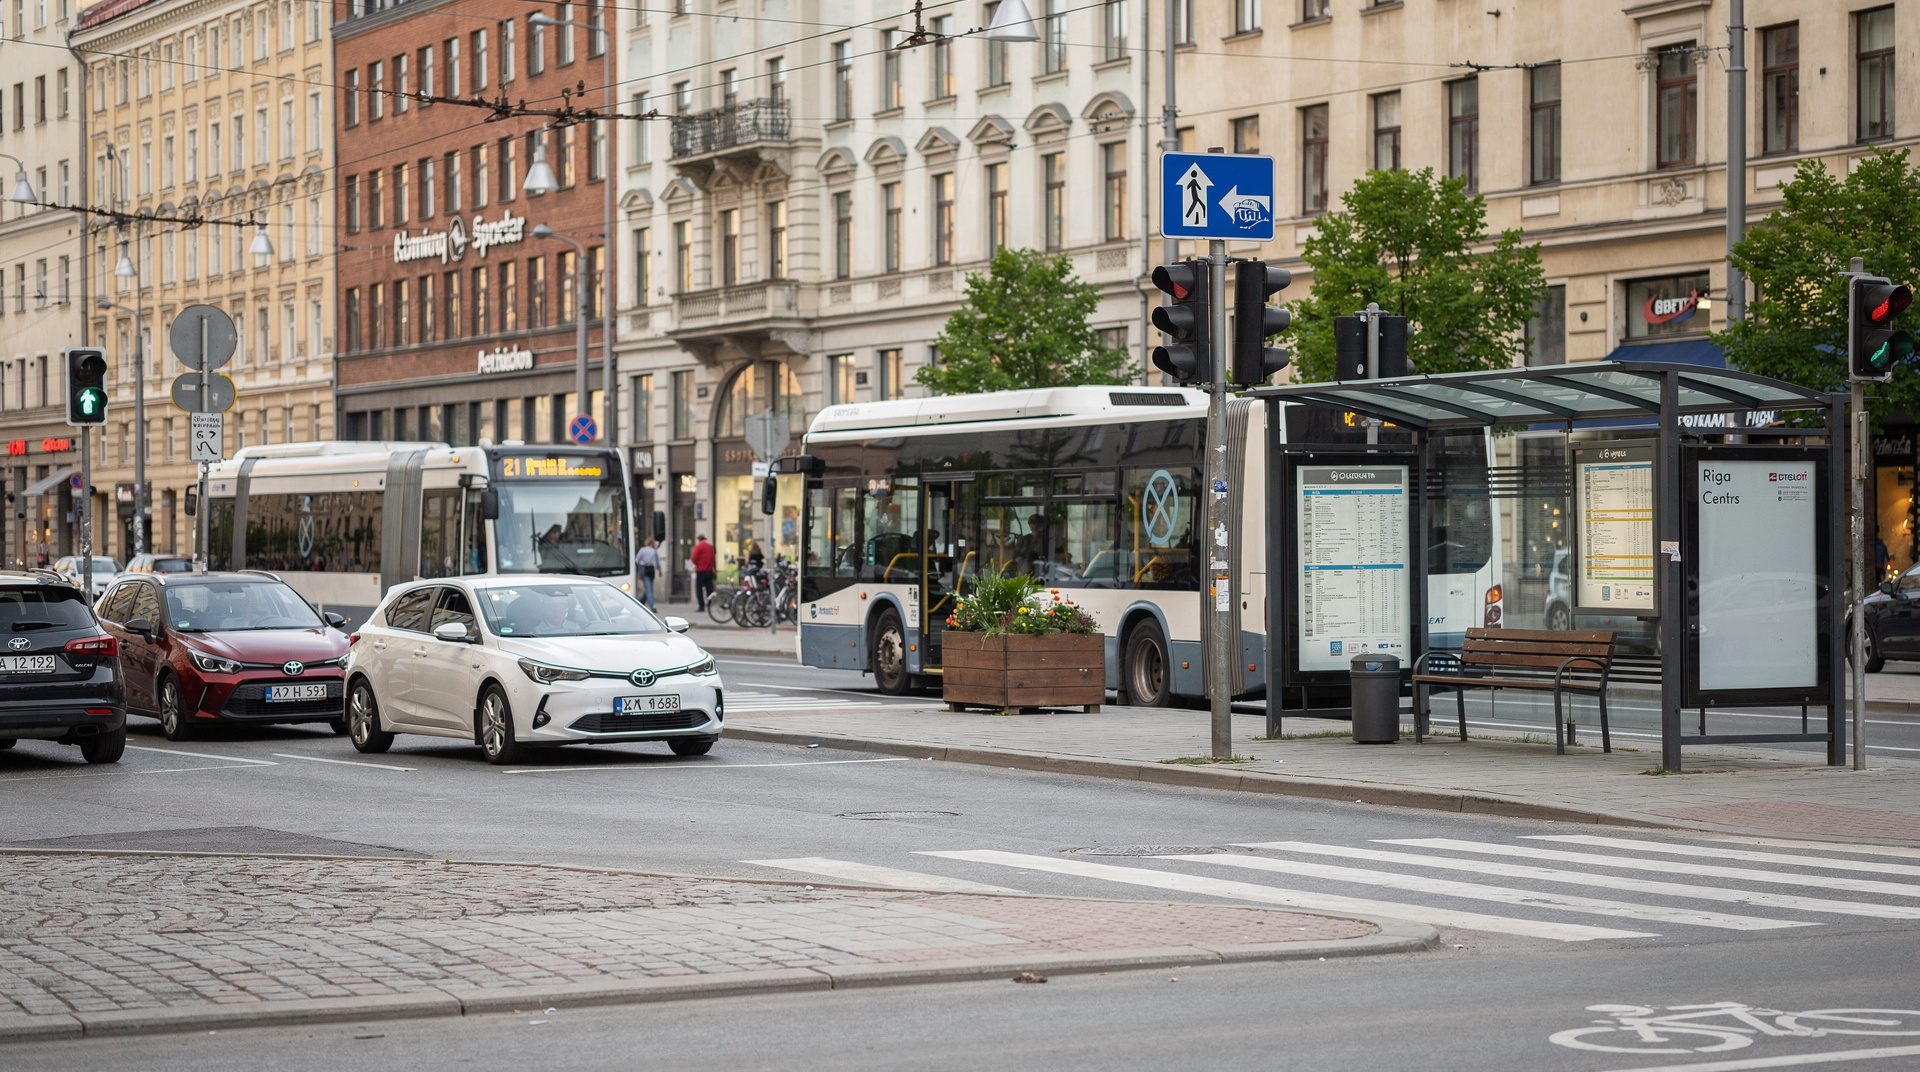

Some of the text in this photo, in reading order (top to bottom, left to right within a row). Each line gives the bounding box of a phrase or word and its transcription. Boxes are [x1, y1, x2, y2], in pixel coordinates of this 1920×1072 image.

[503, 458, 520, 476] 21
[1703, 469, 1731, 485] Riga
[1702, 491, 1740, 504] Centrs
